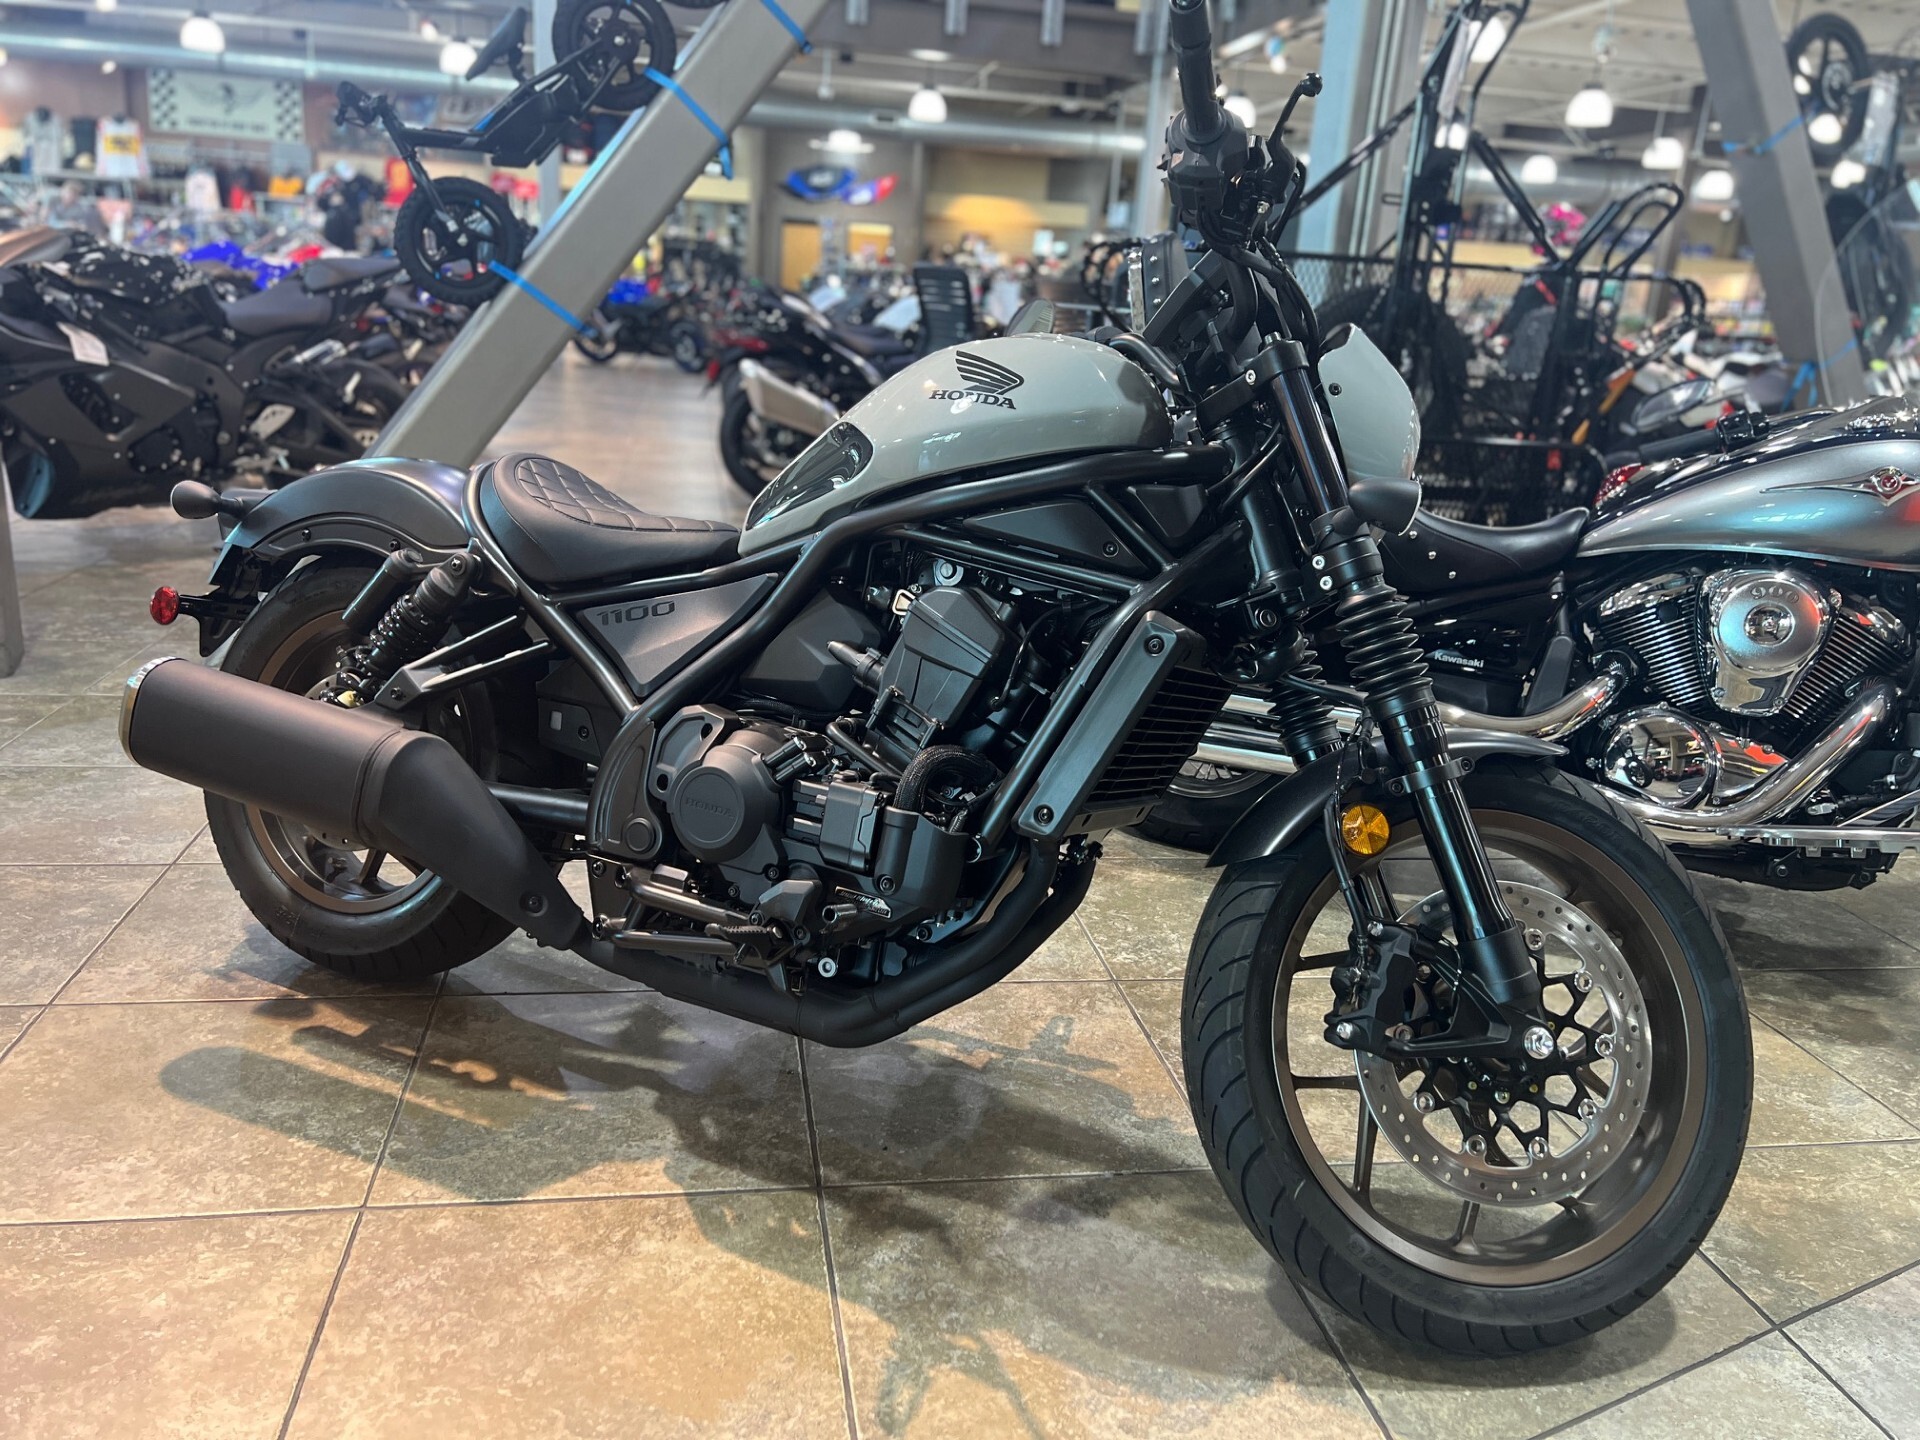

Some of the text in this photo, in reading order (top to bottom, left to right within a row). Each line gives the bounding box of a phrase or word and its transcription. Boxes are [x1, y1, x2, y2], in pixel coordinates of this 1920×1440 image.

[929, 389, 1016, 409] HONDA
[1750, 584, 1800, 603] 900
[597, 601, 675, 626] 1100
[1434, 651, 1485, 668] Kawasaki
